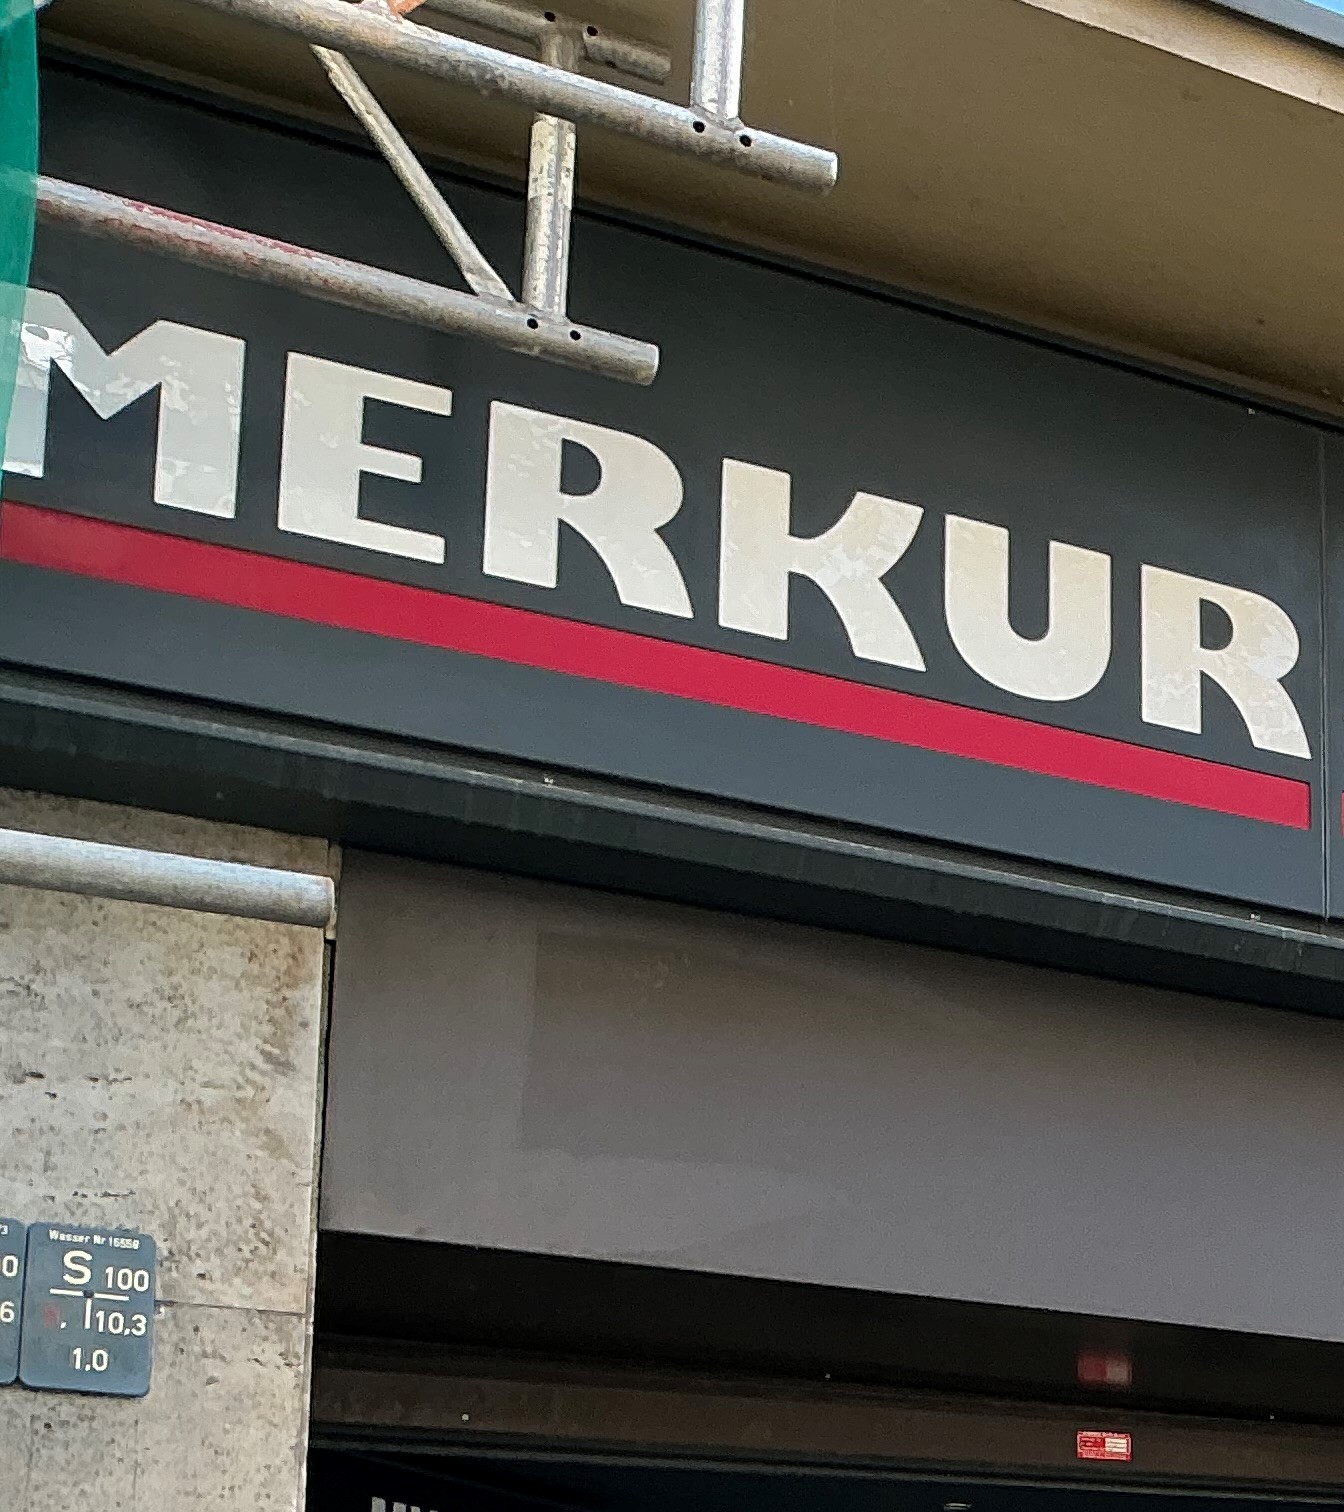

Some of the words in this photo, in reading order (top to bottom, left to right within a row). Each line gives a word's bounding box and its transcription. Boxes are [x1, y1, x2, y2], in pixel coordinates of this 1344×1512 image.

[0, 287, 1311, 760] MERKUR
[49, 1229, 90, 1243] Wasser
[63, 1250, 92, 1285] S
[105, 1266, 149, 1292] 100
